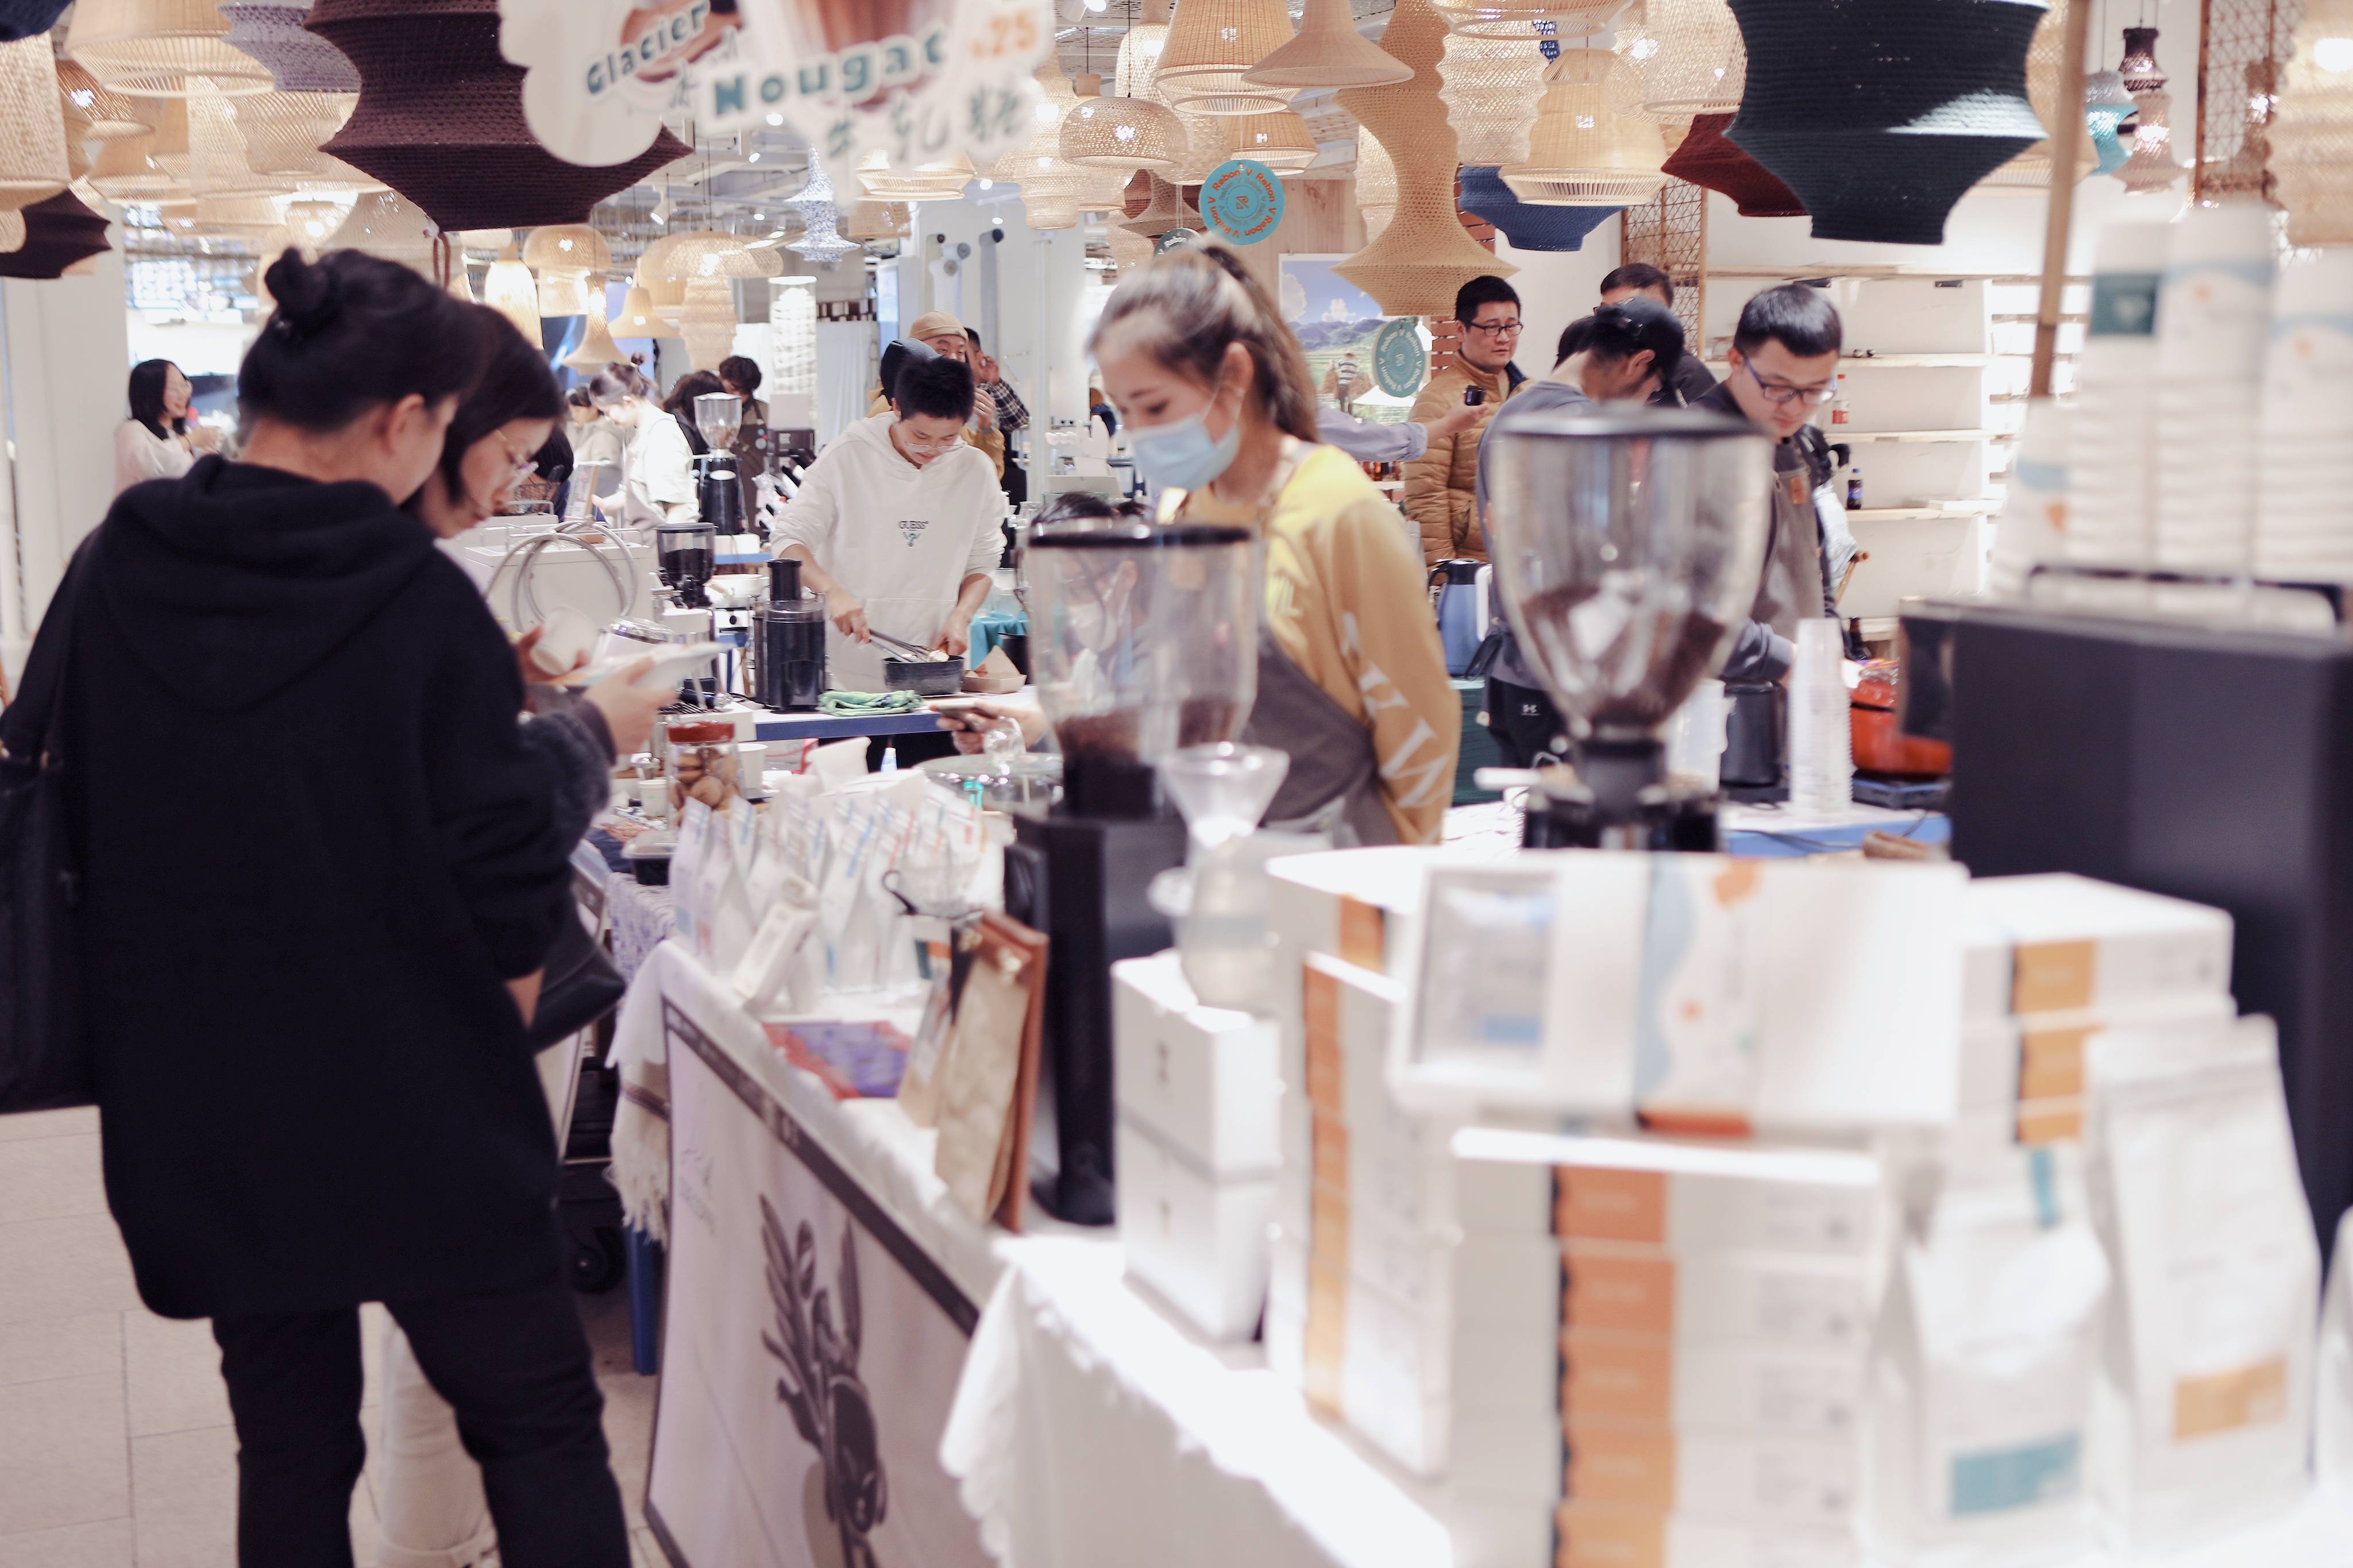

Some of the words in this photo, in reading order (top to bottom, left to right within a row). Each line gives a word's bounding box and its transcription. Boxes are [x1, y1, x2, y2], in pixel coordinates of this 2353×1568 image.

[587, 2, 706, 94] Glacier
[715, 29, 944, 117] Nougat
[1212, 169, 1241, 191] Rebon
[1256, 172, 1275, 202] Rebon
